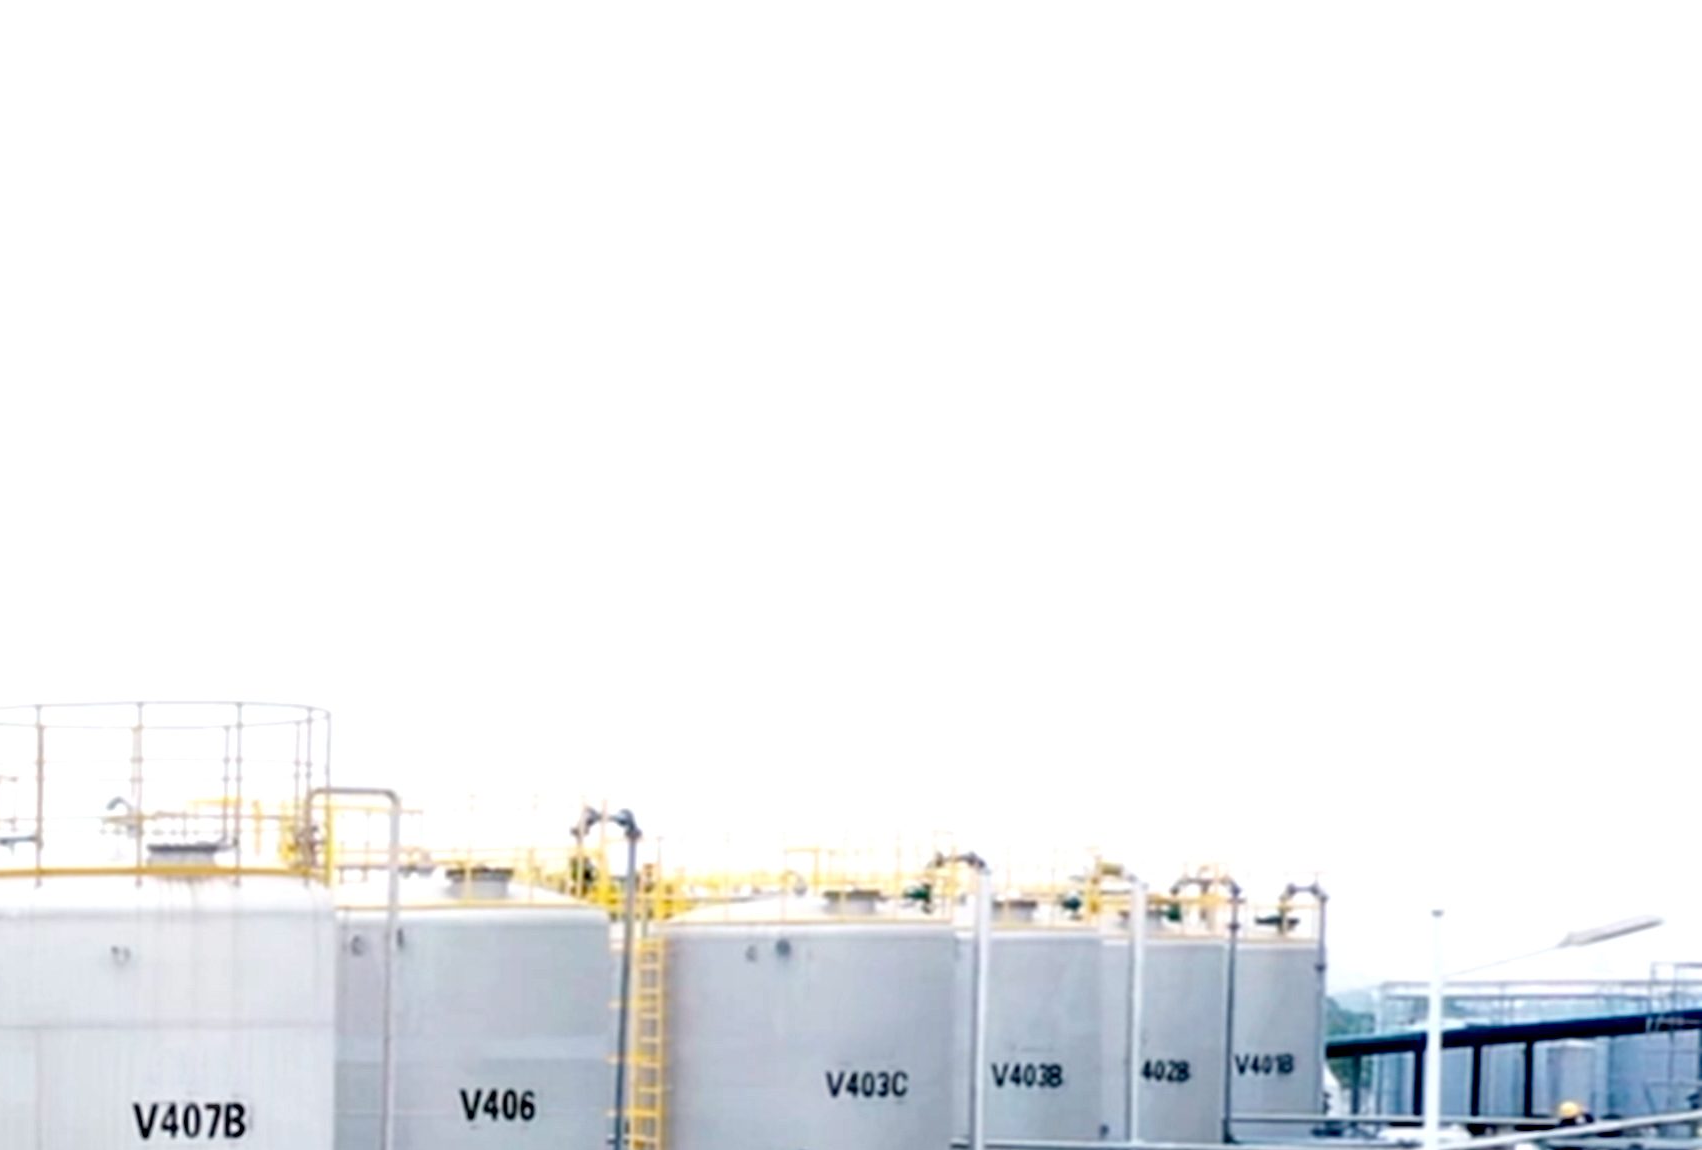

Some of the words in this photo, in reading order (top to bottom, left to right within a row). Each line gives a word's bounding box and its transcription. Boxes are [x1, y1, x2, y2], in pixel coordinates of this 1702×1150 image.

[991, 1063, 1064, 1089] V403B
[1141, 1060, 1191, 1083] 402B
[1234, 1053, 1295, 1076] V401B
[826, 1071, 908, 1098] V403C
[460, 1088, 536, 1122] V406
[133, 1102, 246, 1140] V407B
